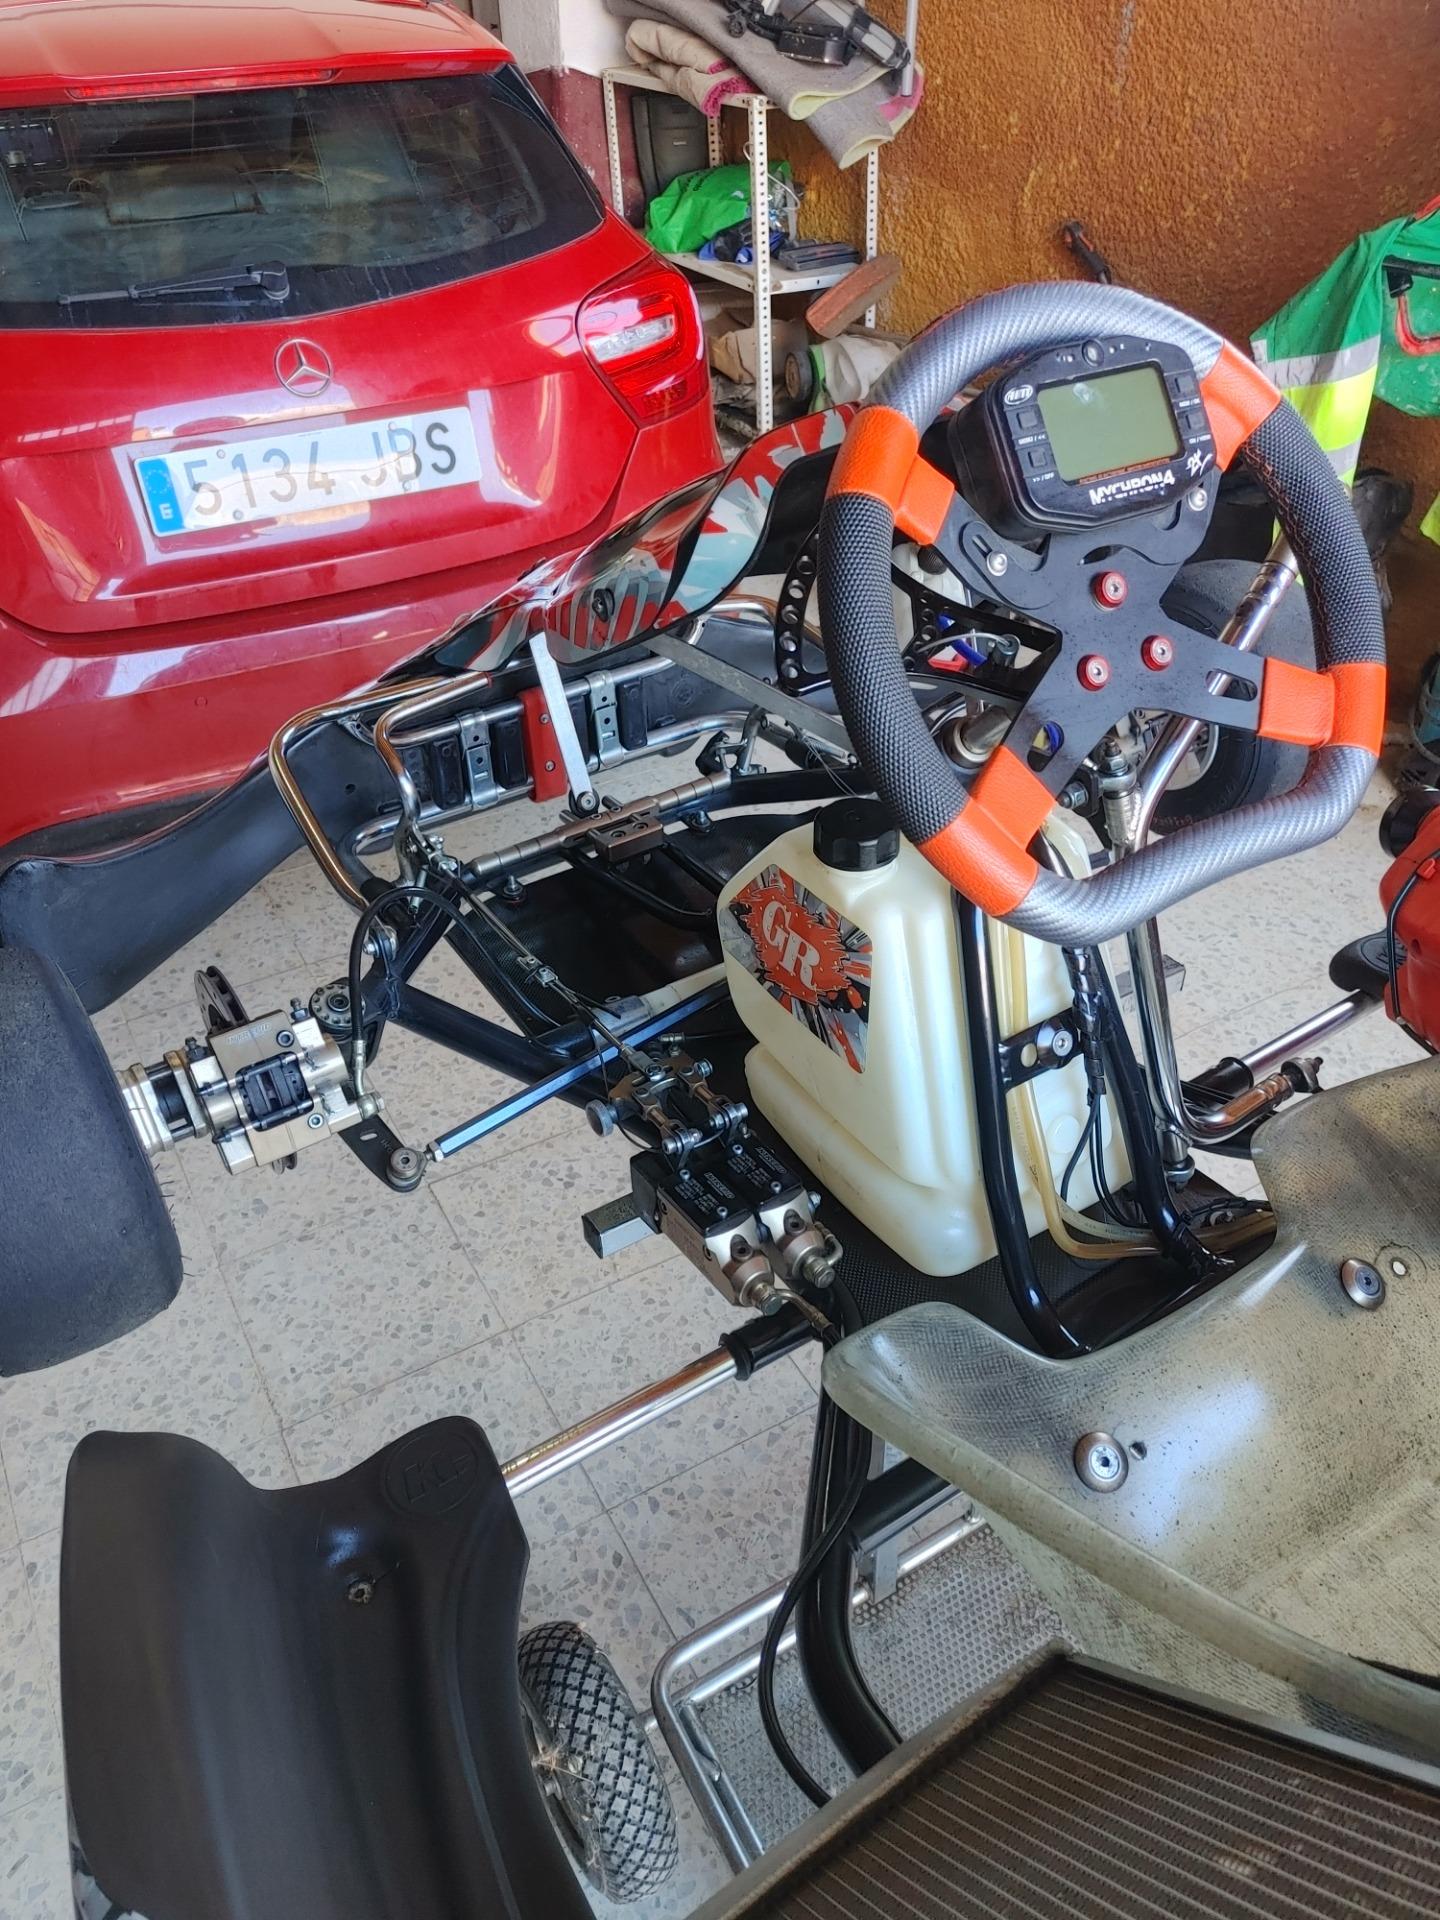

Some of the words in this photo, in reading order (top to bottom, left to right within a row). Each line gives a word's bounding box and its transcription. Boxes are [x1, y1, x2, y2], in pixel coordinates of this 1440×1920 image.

[183, 441, 336, 516] 5134
[361, 421, 457, 488] JBS
[762, 900, 821, 991] GR
